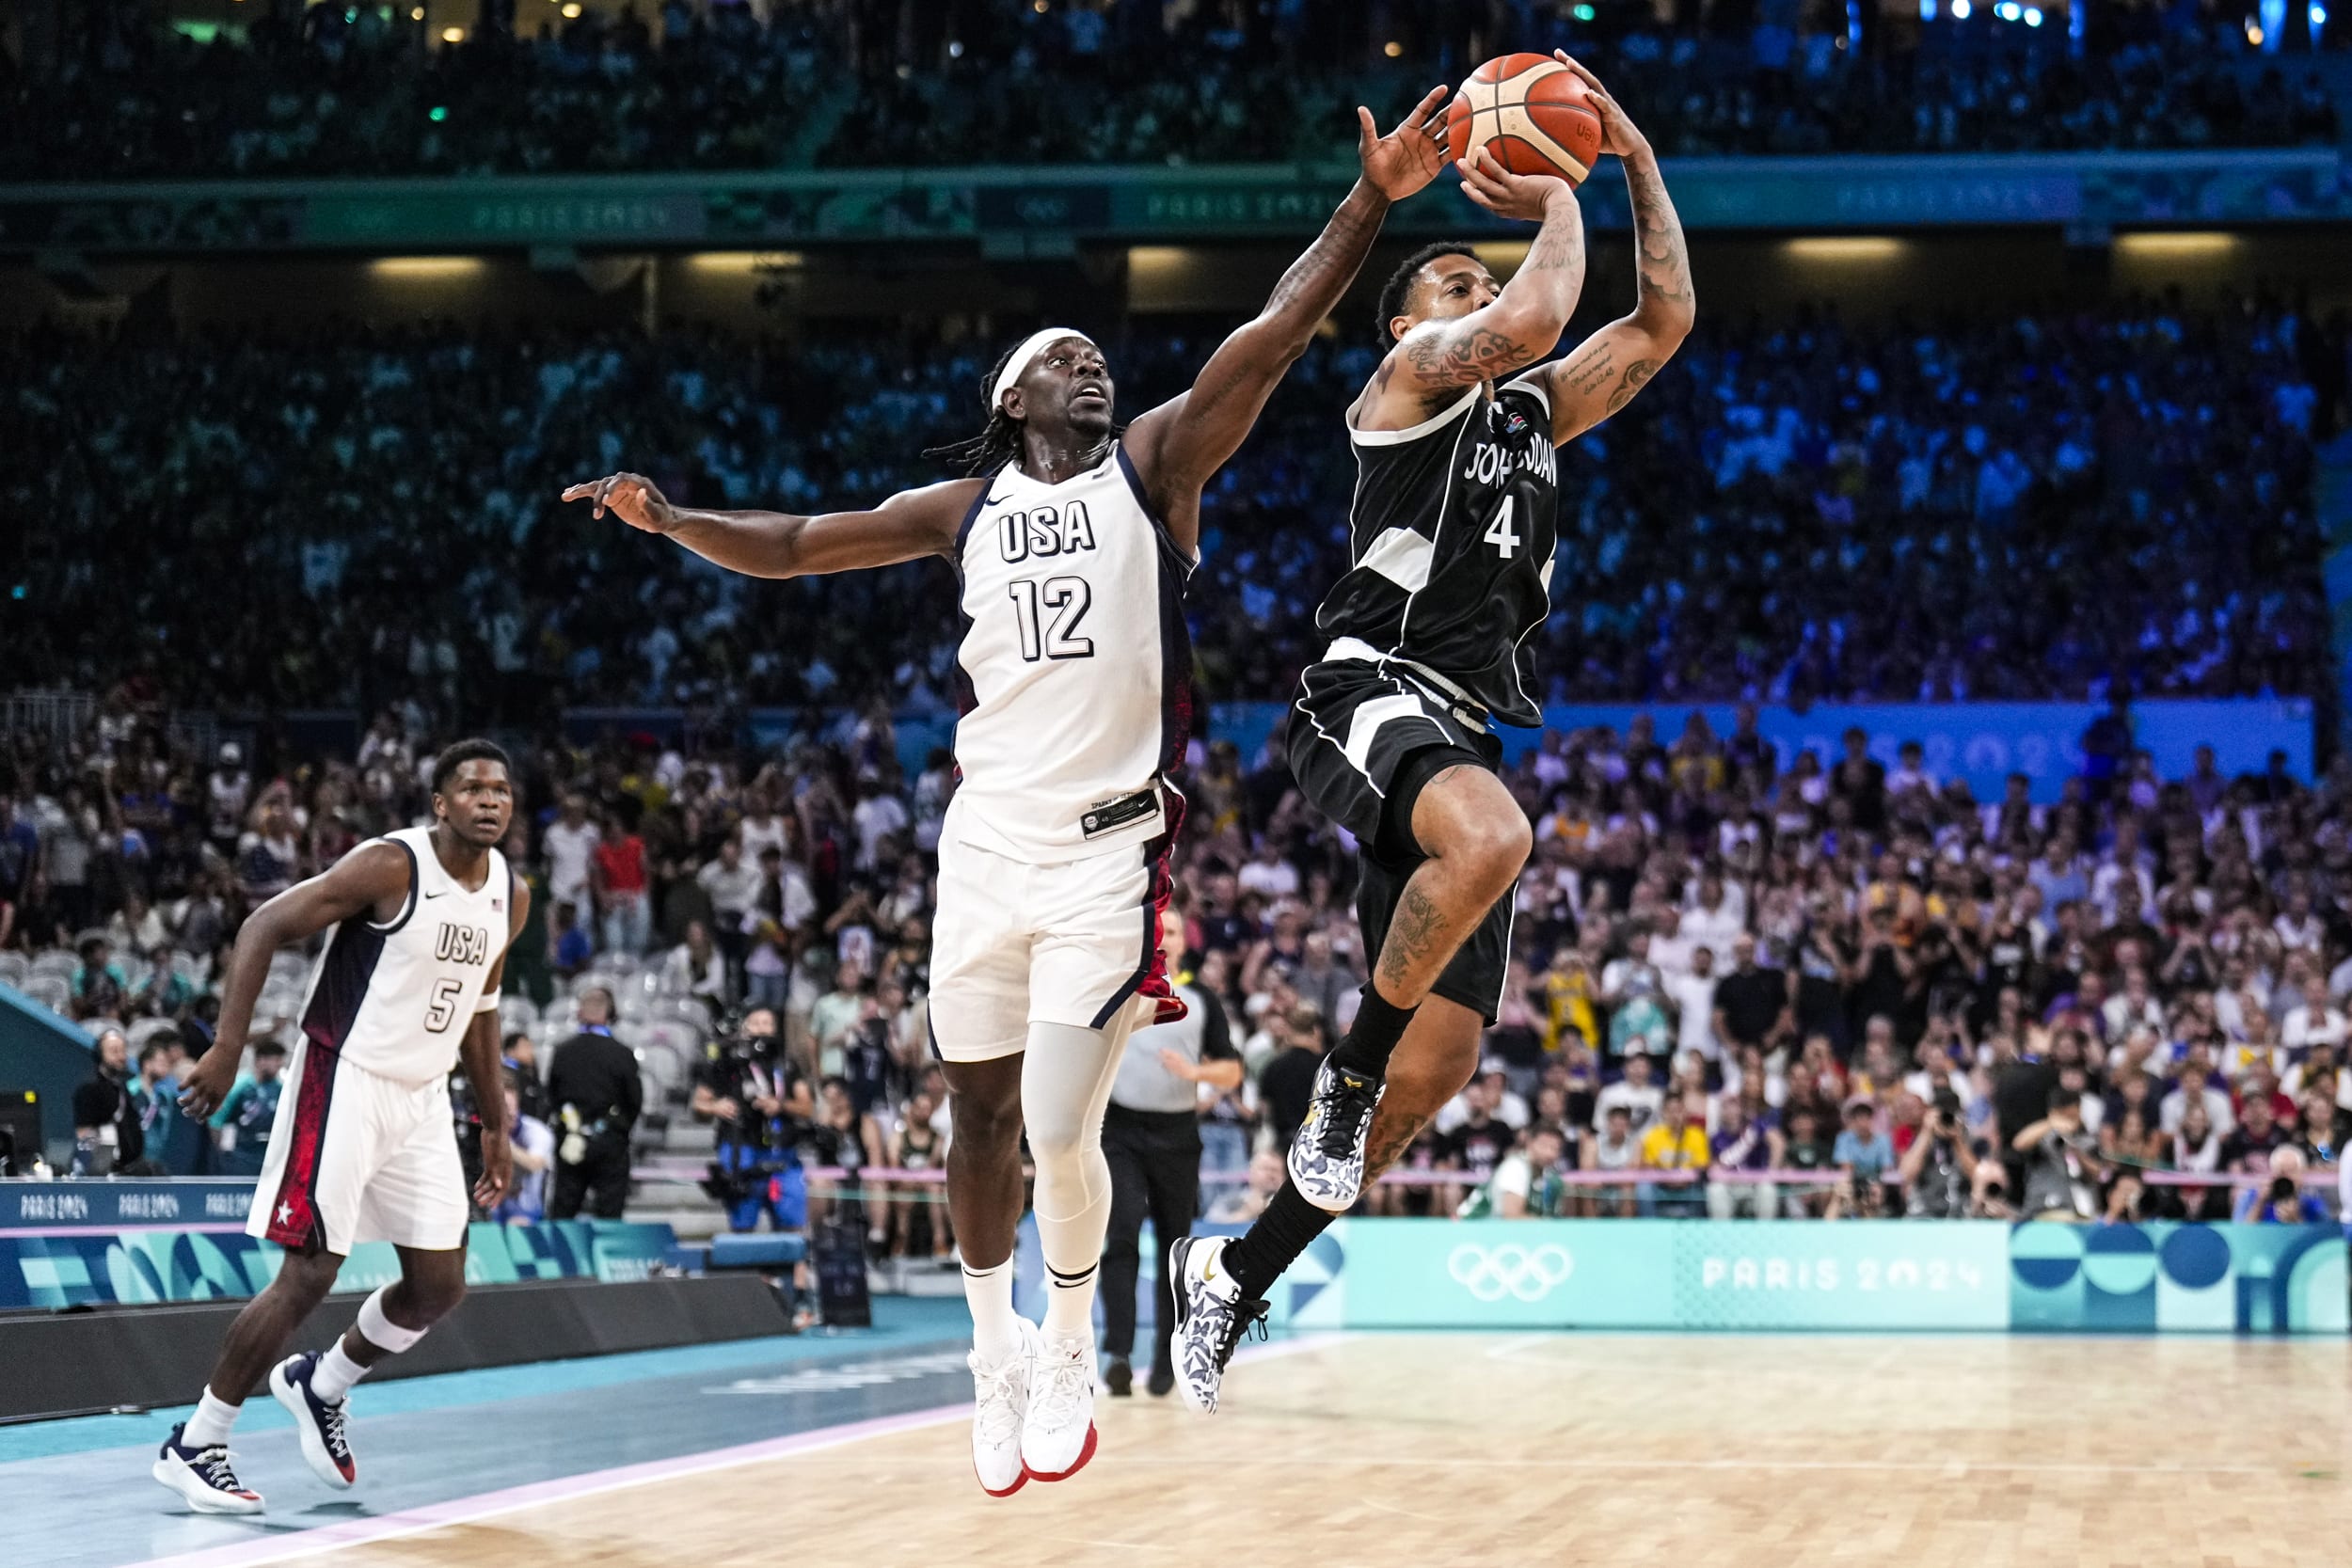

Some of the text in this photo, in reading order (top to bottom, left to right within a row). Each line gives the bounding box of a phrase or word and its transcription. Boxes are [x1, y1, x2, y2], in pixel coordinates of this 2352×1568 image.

[999, 499, 1096, 564] USA
[1484, 495, 1520, 559] 4
[1009, 576, 1095, 662] 12
[435, 922, 487, 966] USA
[423, 977, 463, 1034] 5
[21, 1194, 88, 1219] PARIS 2024
[119, 1194, 180, 1219] PARIS 2024
[1702, 1257, 1982, 1291] PARIS 2024
